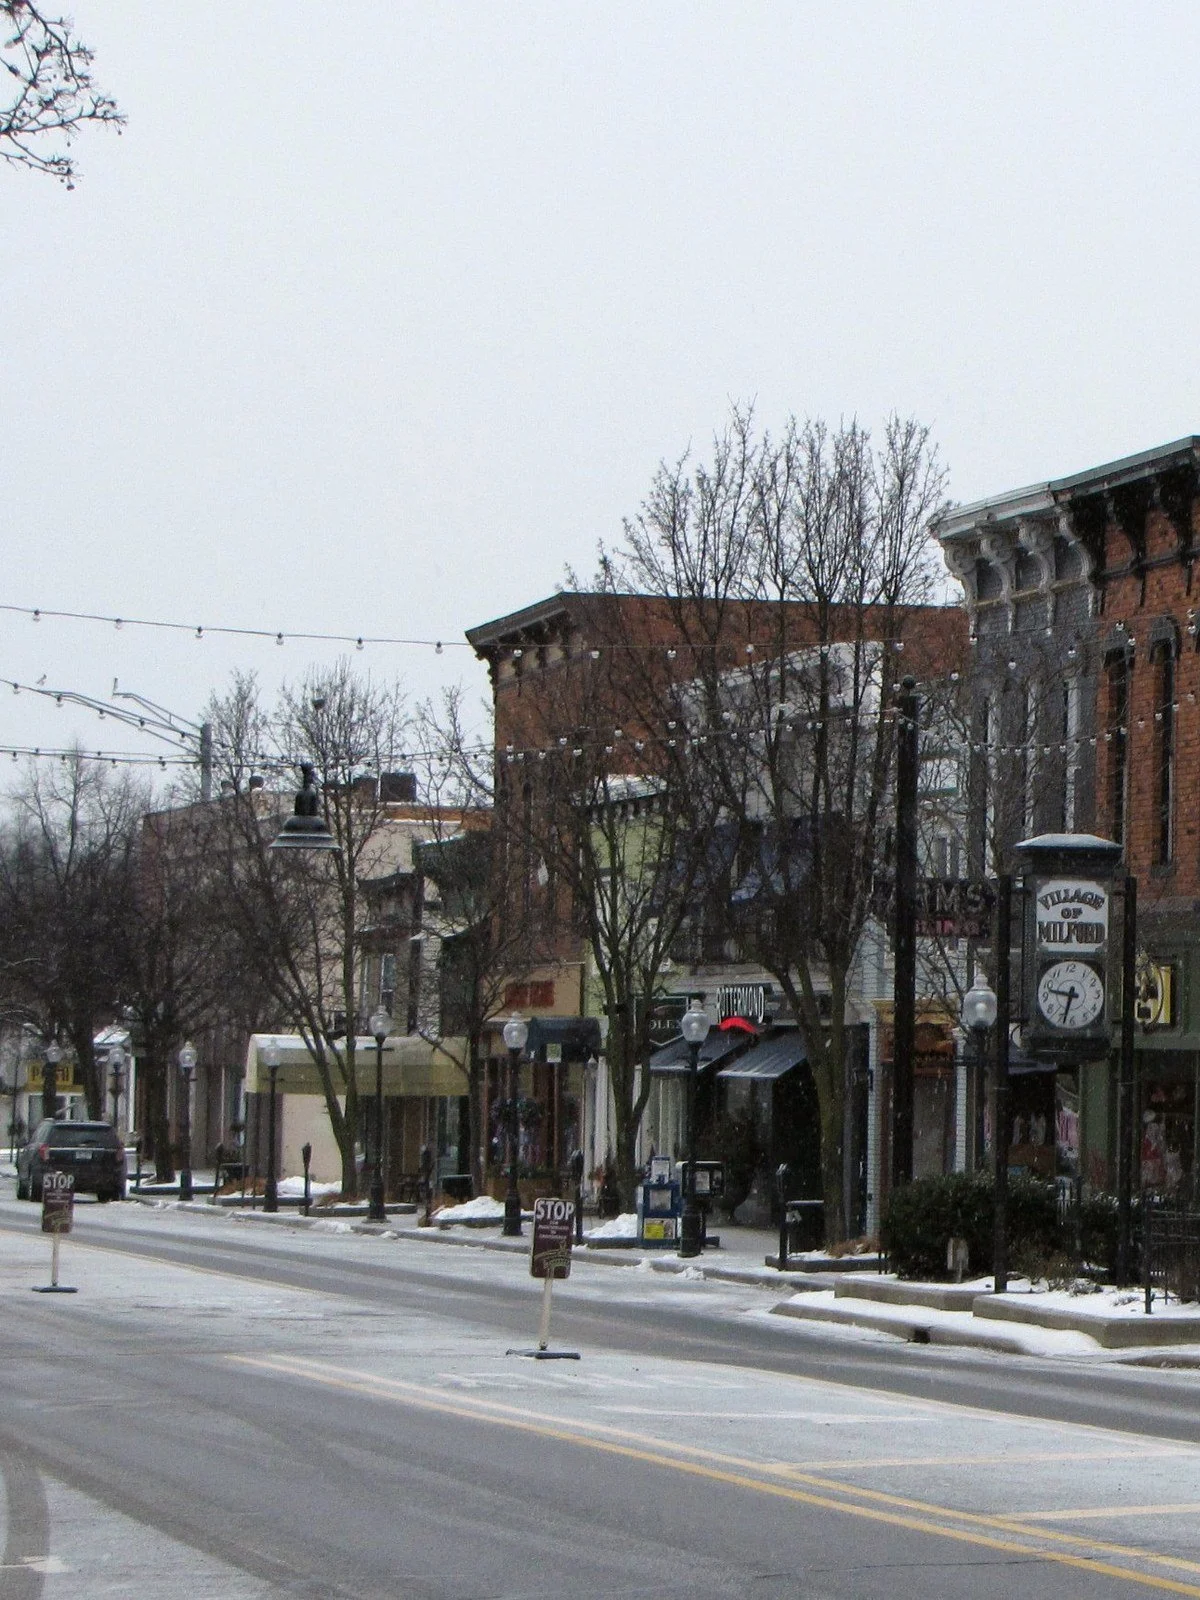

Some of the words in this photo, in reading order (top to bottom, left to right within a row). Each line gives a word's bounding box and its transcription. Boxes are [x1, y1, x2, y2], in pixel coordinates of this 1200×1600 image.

[1038, 888, 1106, 911] VILLAGE
[1060, 907, 1083, 919] OF
[1038, 921, 1105, 944] MILFORD
[43, 1173, 75, 1189] STOP
[536, 1200, 575, 1220] STOP
